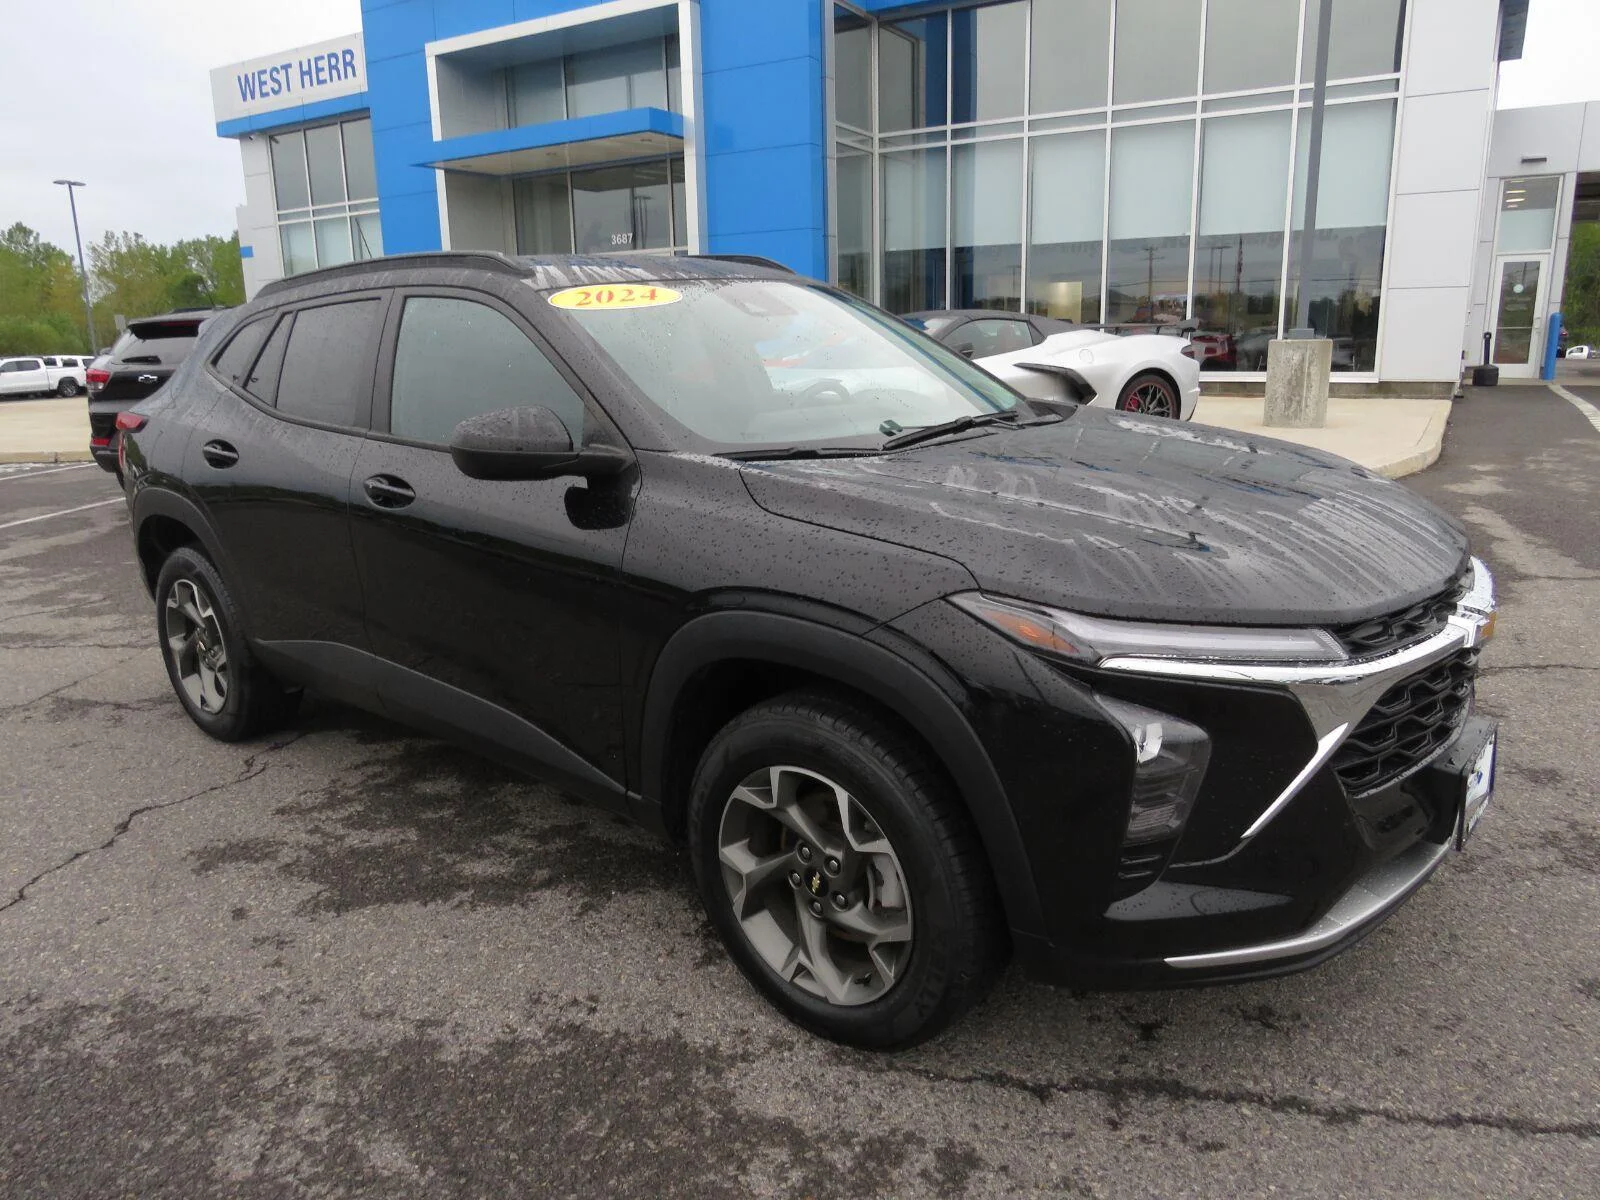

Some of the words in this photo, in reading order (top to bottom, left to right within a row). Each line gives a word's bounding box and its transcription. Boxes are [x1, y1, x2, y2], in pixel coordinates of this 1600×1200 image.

[237, 63, 292, 102] WEST
[298, 48, 357, 89] HERR
[611, 232, 633, 245] 3687
[576, 288, 658, 306] 2024
